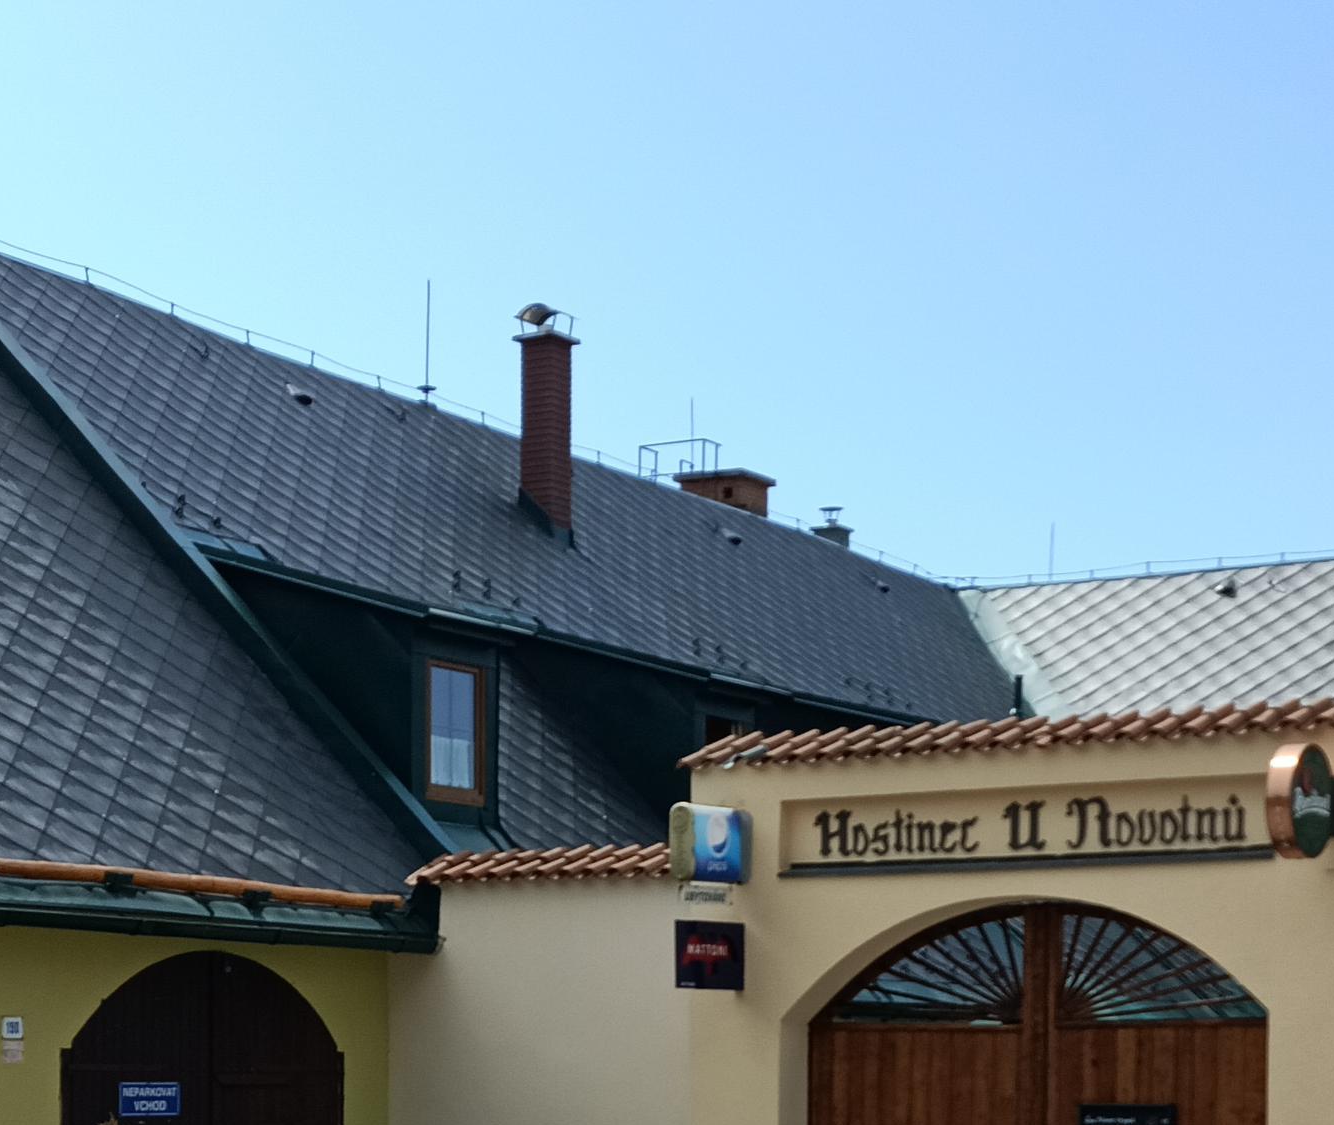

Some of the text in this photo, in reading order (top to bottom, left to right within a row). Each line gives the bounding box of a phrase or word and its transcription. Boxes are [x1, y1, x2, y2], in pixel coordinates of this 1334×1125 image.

[814, 794, 1247, 857] Hostinec U Novotnů
[122, 1086, 178, 1098] NEPARKOVAT
[133, 1100, 167, 1112] VCHOD
